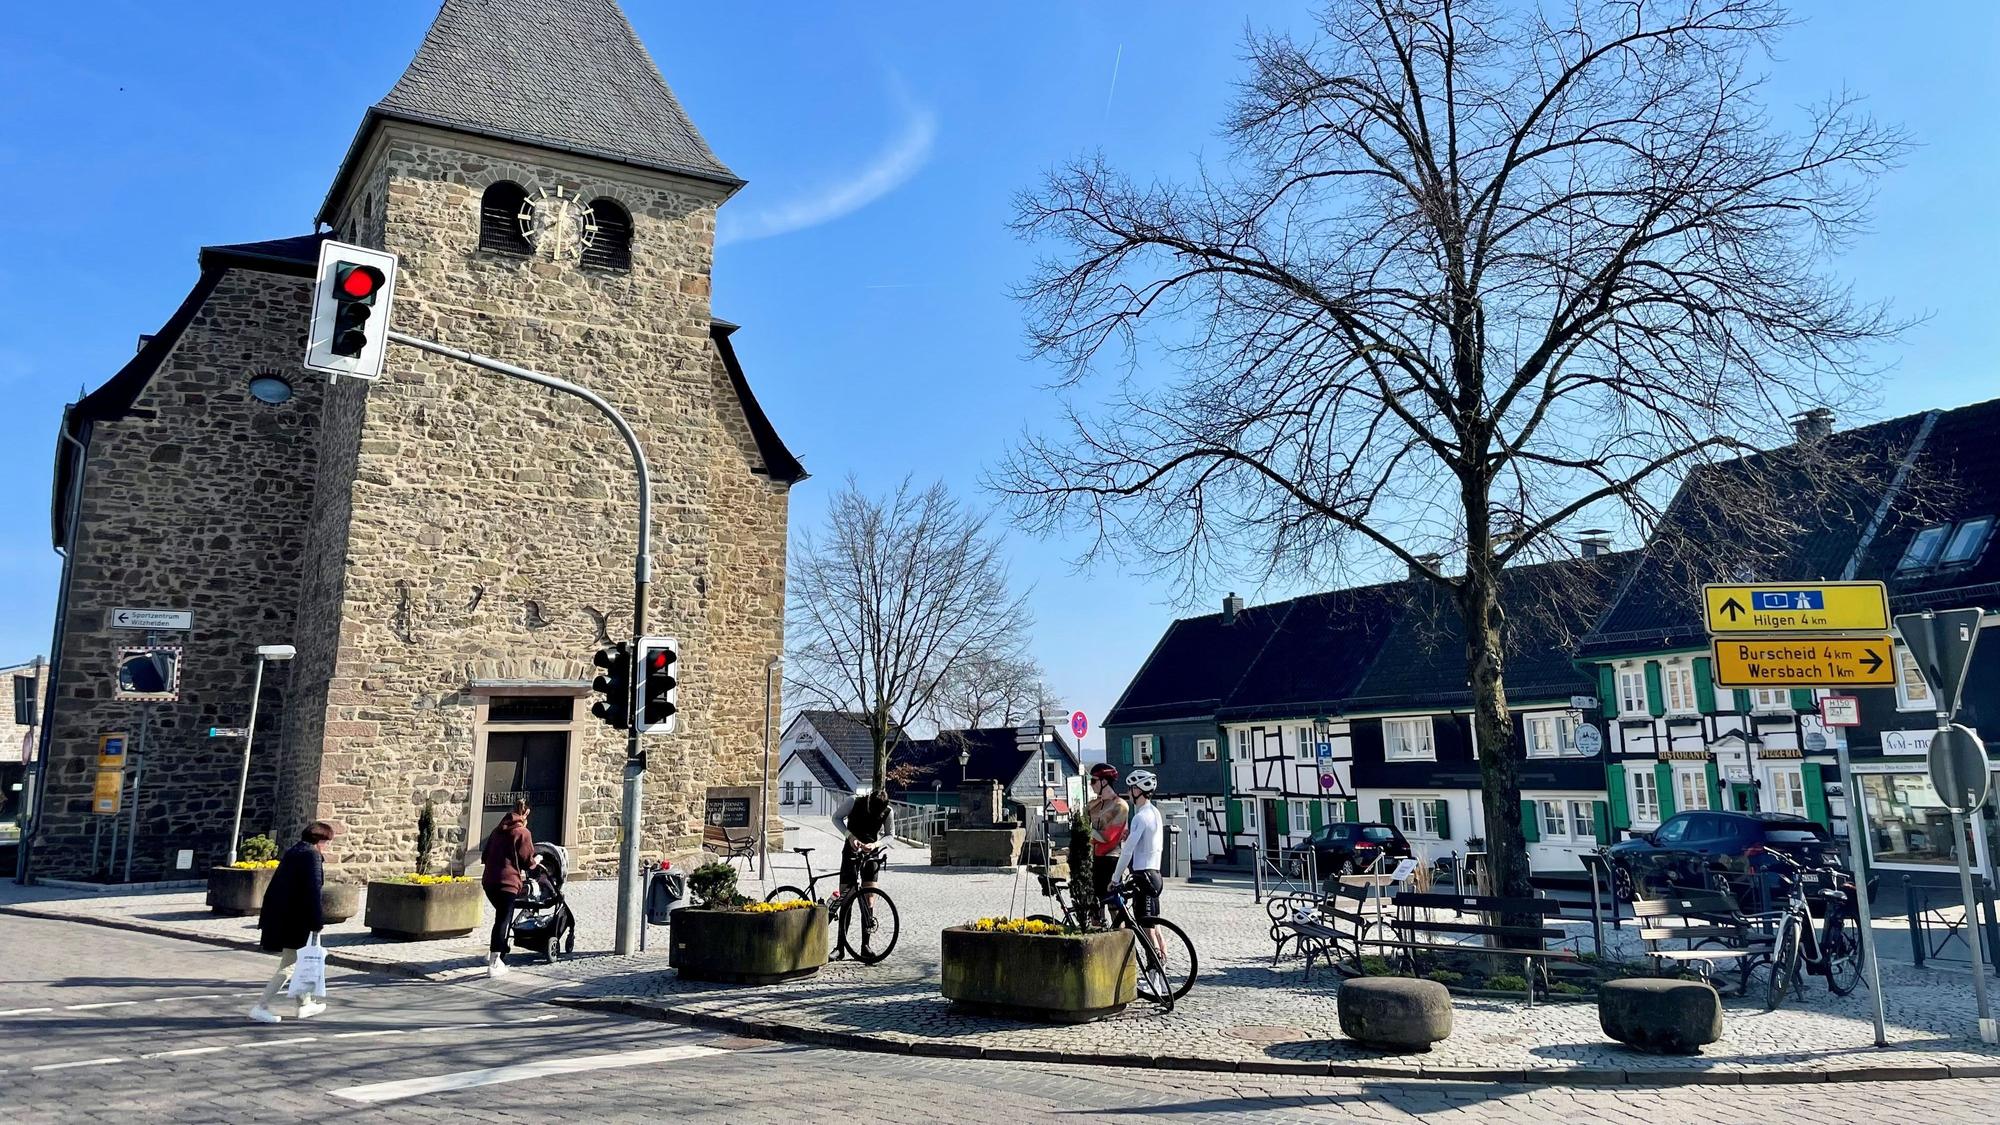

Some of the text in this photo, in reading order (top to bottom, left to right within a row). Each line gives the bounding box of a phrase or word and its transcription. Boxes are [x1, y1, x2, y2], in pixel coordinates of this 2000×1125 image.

[1773, 595, 1779, 606] 1
[131, 611, 180, 620] Sportzentrum
[1753, 613, 1827, 628] Hilgen 4 km
[1739, 645, 1852, 660] Burscheid 4 km
[1748, 662, 1855, 678] Wersbach 1 km
[1320, 744, 1329, 756] P
[1658, 751, 1711, 760] RISTORANTE
[1759, 749, 1803, 758] PIZZERIA
